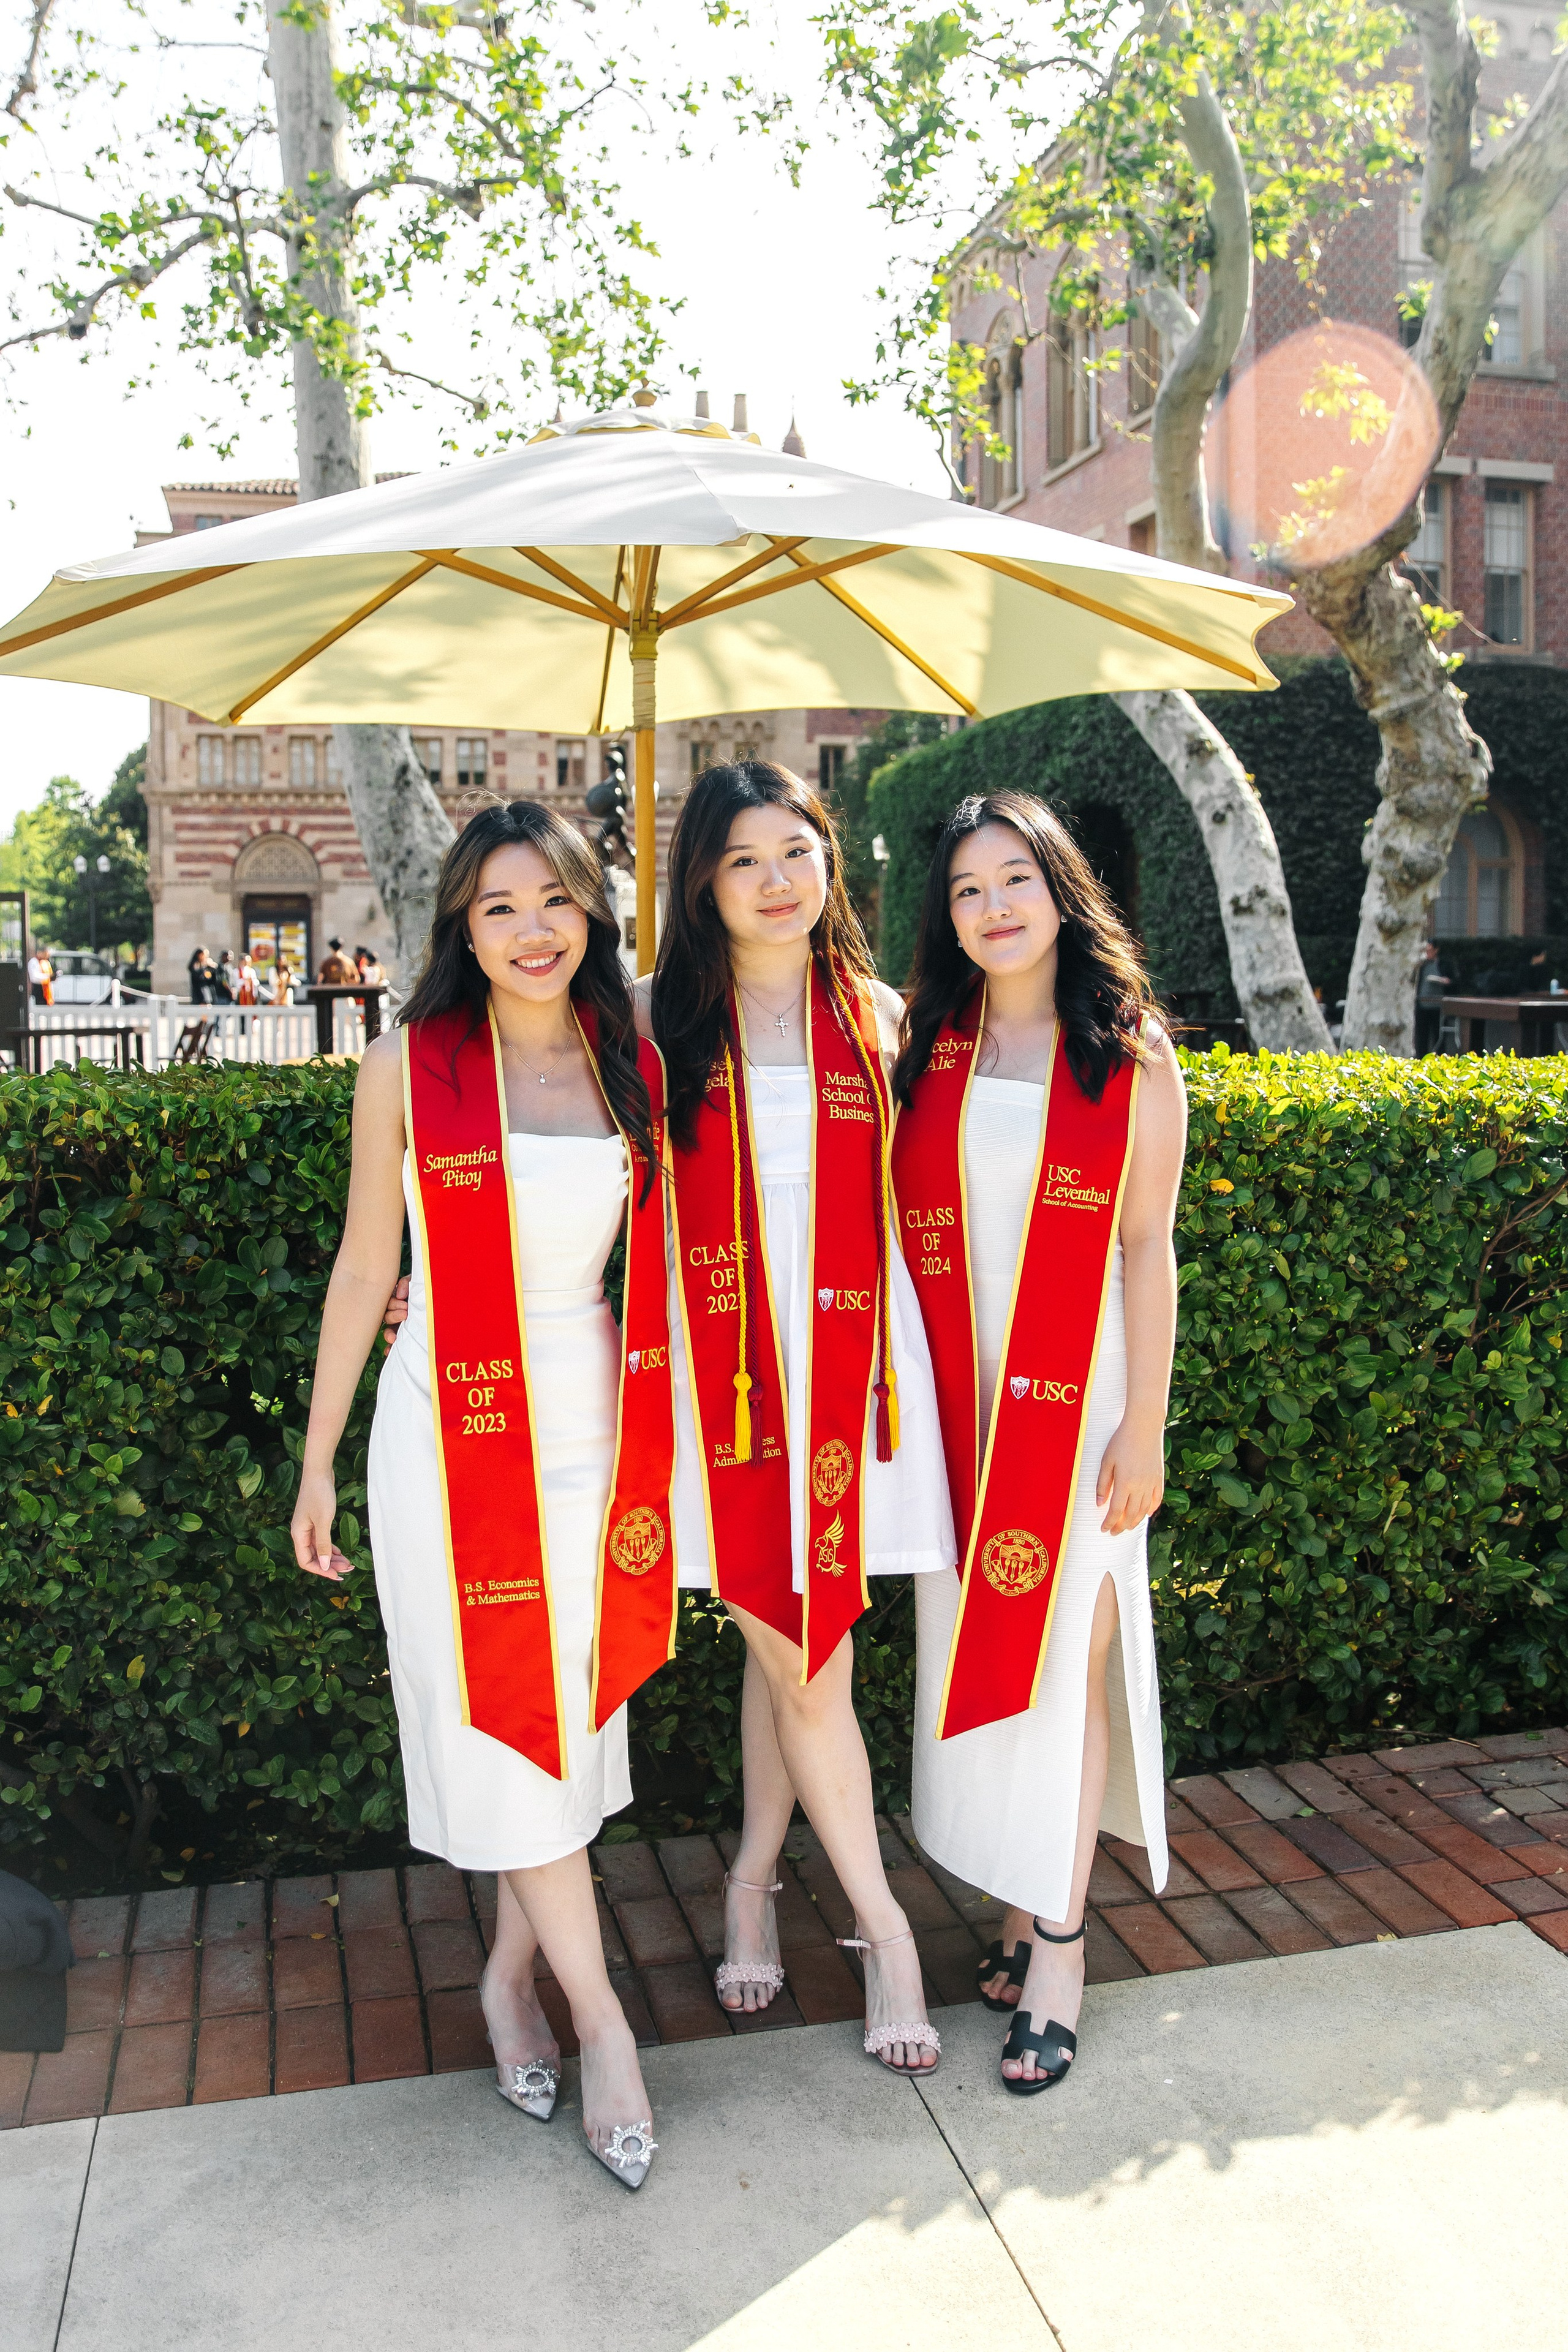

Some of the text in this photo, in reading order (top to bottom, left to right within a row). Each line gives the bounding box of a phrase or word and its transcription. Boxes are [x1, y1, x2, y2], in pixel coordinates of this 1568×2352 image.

[932, 1038, 973, 1055] celyn
[824, 1071, 869, 1089] Marsh
[821, 1087, 865, 1104] School
[828, 1104, 874, 1123] Busines
[423, 1145, 498, 1173] Samantha
[442, 1169, 482, 1191] Pitoy
[1047, 1164, 1080, 1185] USC
[1043, 1180, 1110, 1205] Leventhal
[1041, 1197, 1060, 1206] School
[1067, 1202, 1098, 1212] Accounting
[906, 1207, 955, 1229] CLASS
[922, 1232, 940, 1251] OF
[921, 1256, 951, 1275] 2024
[710, 1267, 735, 1289] OF
[707, 1292, 747, 1314] 202
[835, 1290, 870, 1311] USC
[641, 1346, 666, 1370] USC
[446, 1359, 513, 1383] CLASS
[467, 1387, 495, 1408] OF
[1032, 1379, 1078, 1404] USC
[462, 1412, 507, 1434] 2023
[714, 1443, 734, 1455] B.S.
[844, 1453, 853, 1486] CALIFORNIA
[630, 1509, 654, 1518] SOUTHERN
[654, 1519, 663, 1553] CALIFORNIA
[983, 1540, 994, 1577] UNIVERSITY
[1007, 1531, 1040, 1547] SOUTHERN
[1033, 1550, 1047, 1583] CALIFORNIA
[464, 1577, 540, 1593] B.S. Economics
[466, 1589, 541, 1606] & Mathematics
